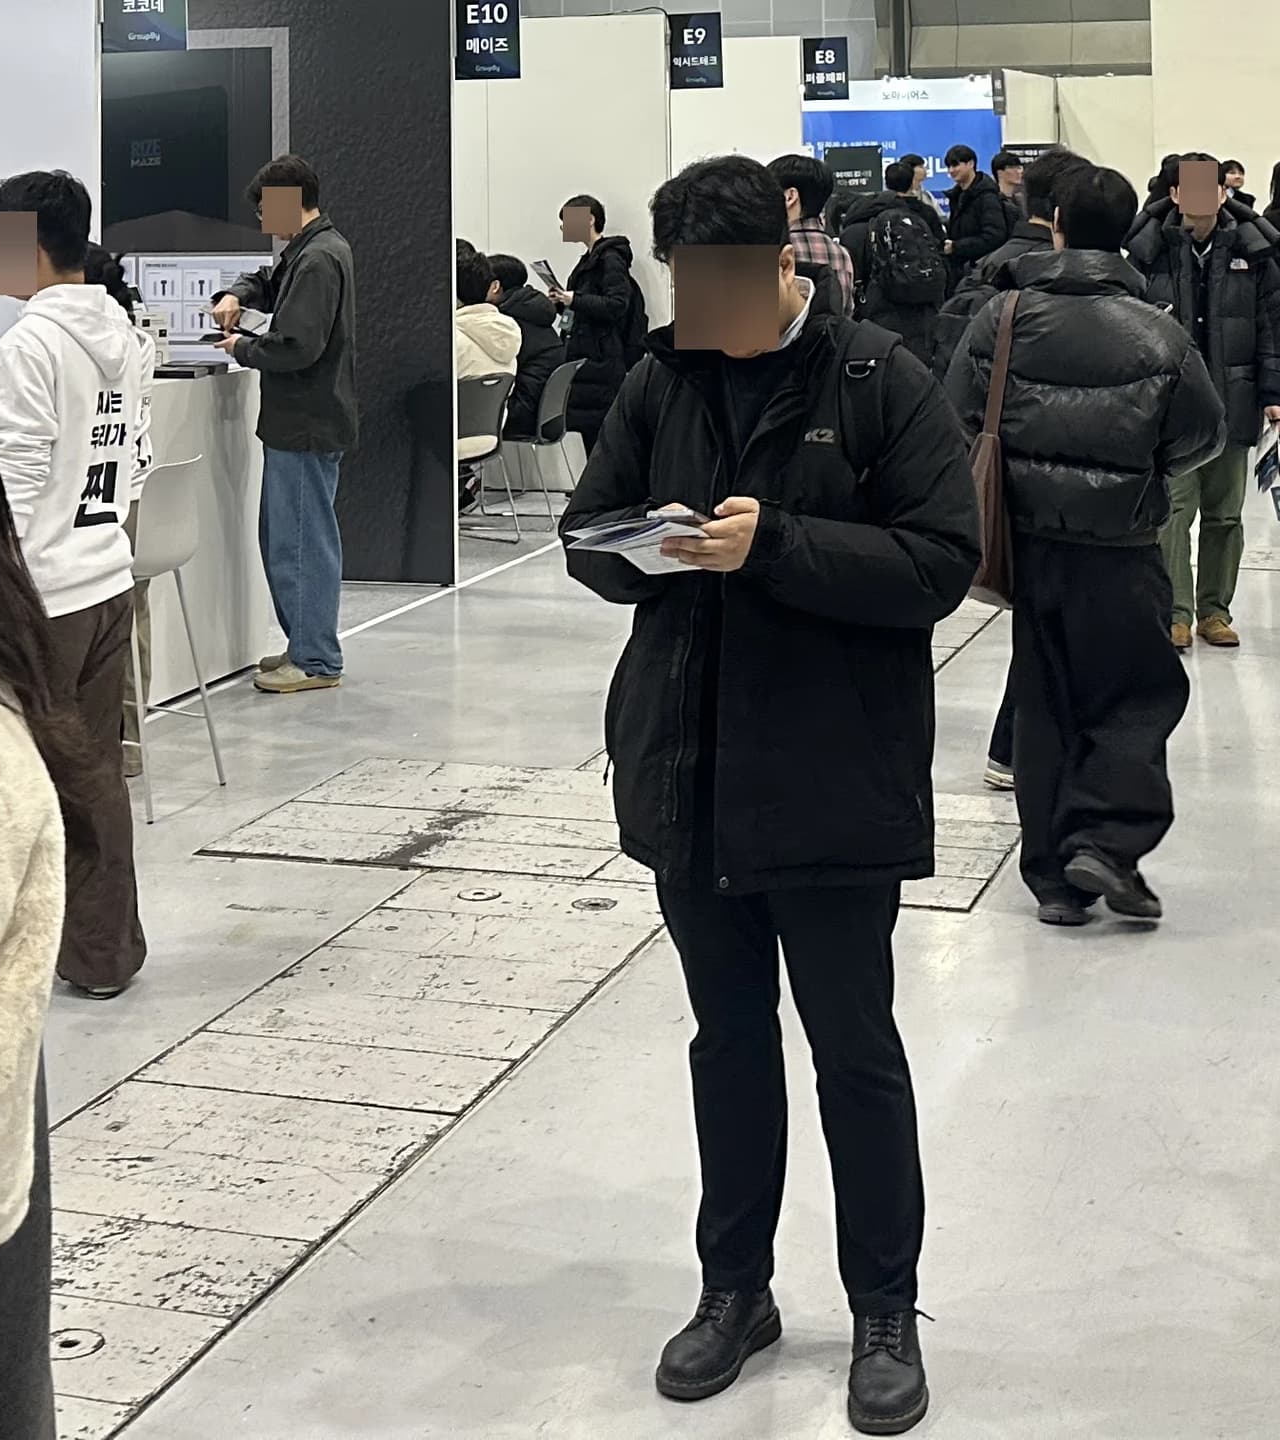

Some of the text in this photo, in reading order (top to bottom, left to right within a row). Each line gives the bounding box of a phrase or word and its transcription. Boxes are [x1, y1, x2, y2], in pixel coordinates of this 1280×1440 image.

[466, 3, 508, 25] E10
[683, 28, 706, 45] E9
[466, 37, 509, 54] 메이즈
[815, 50, 835, 65] E8
